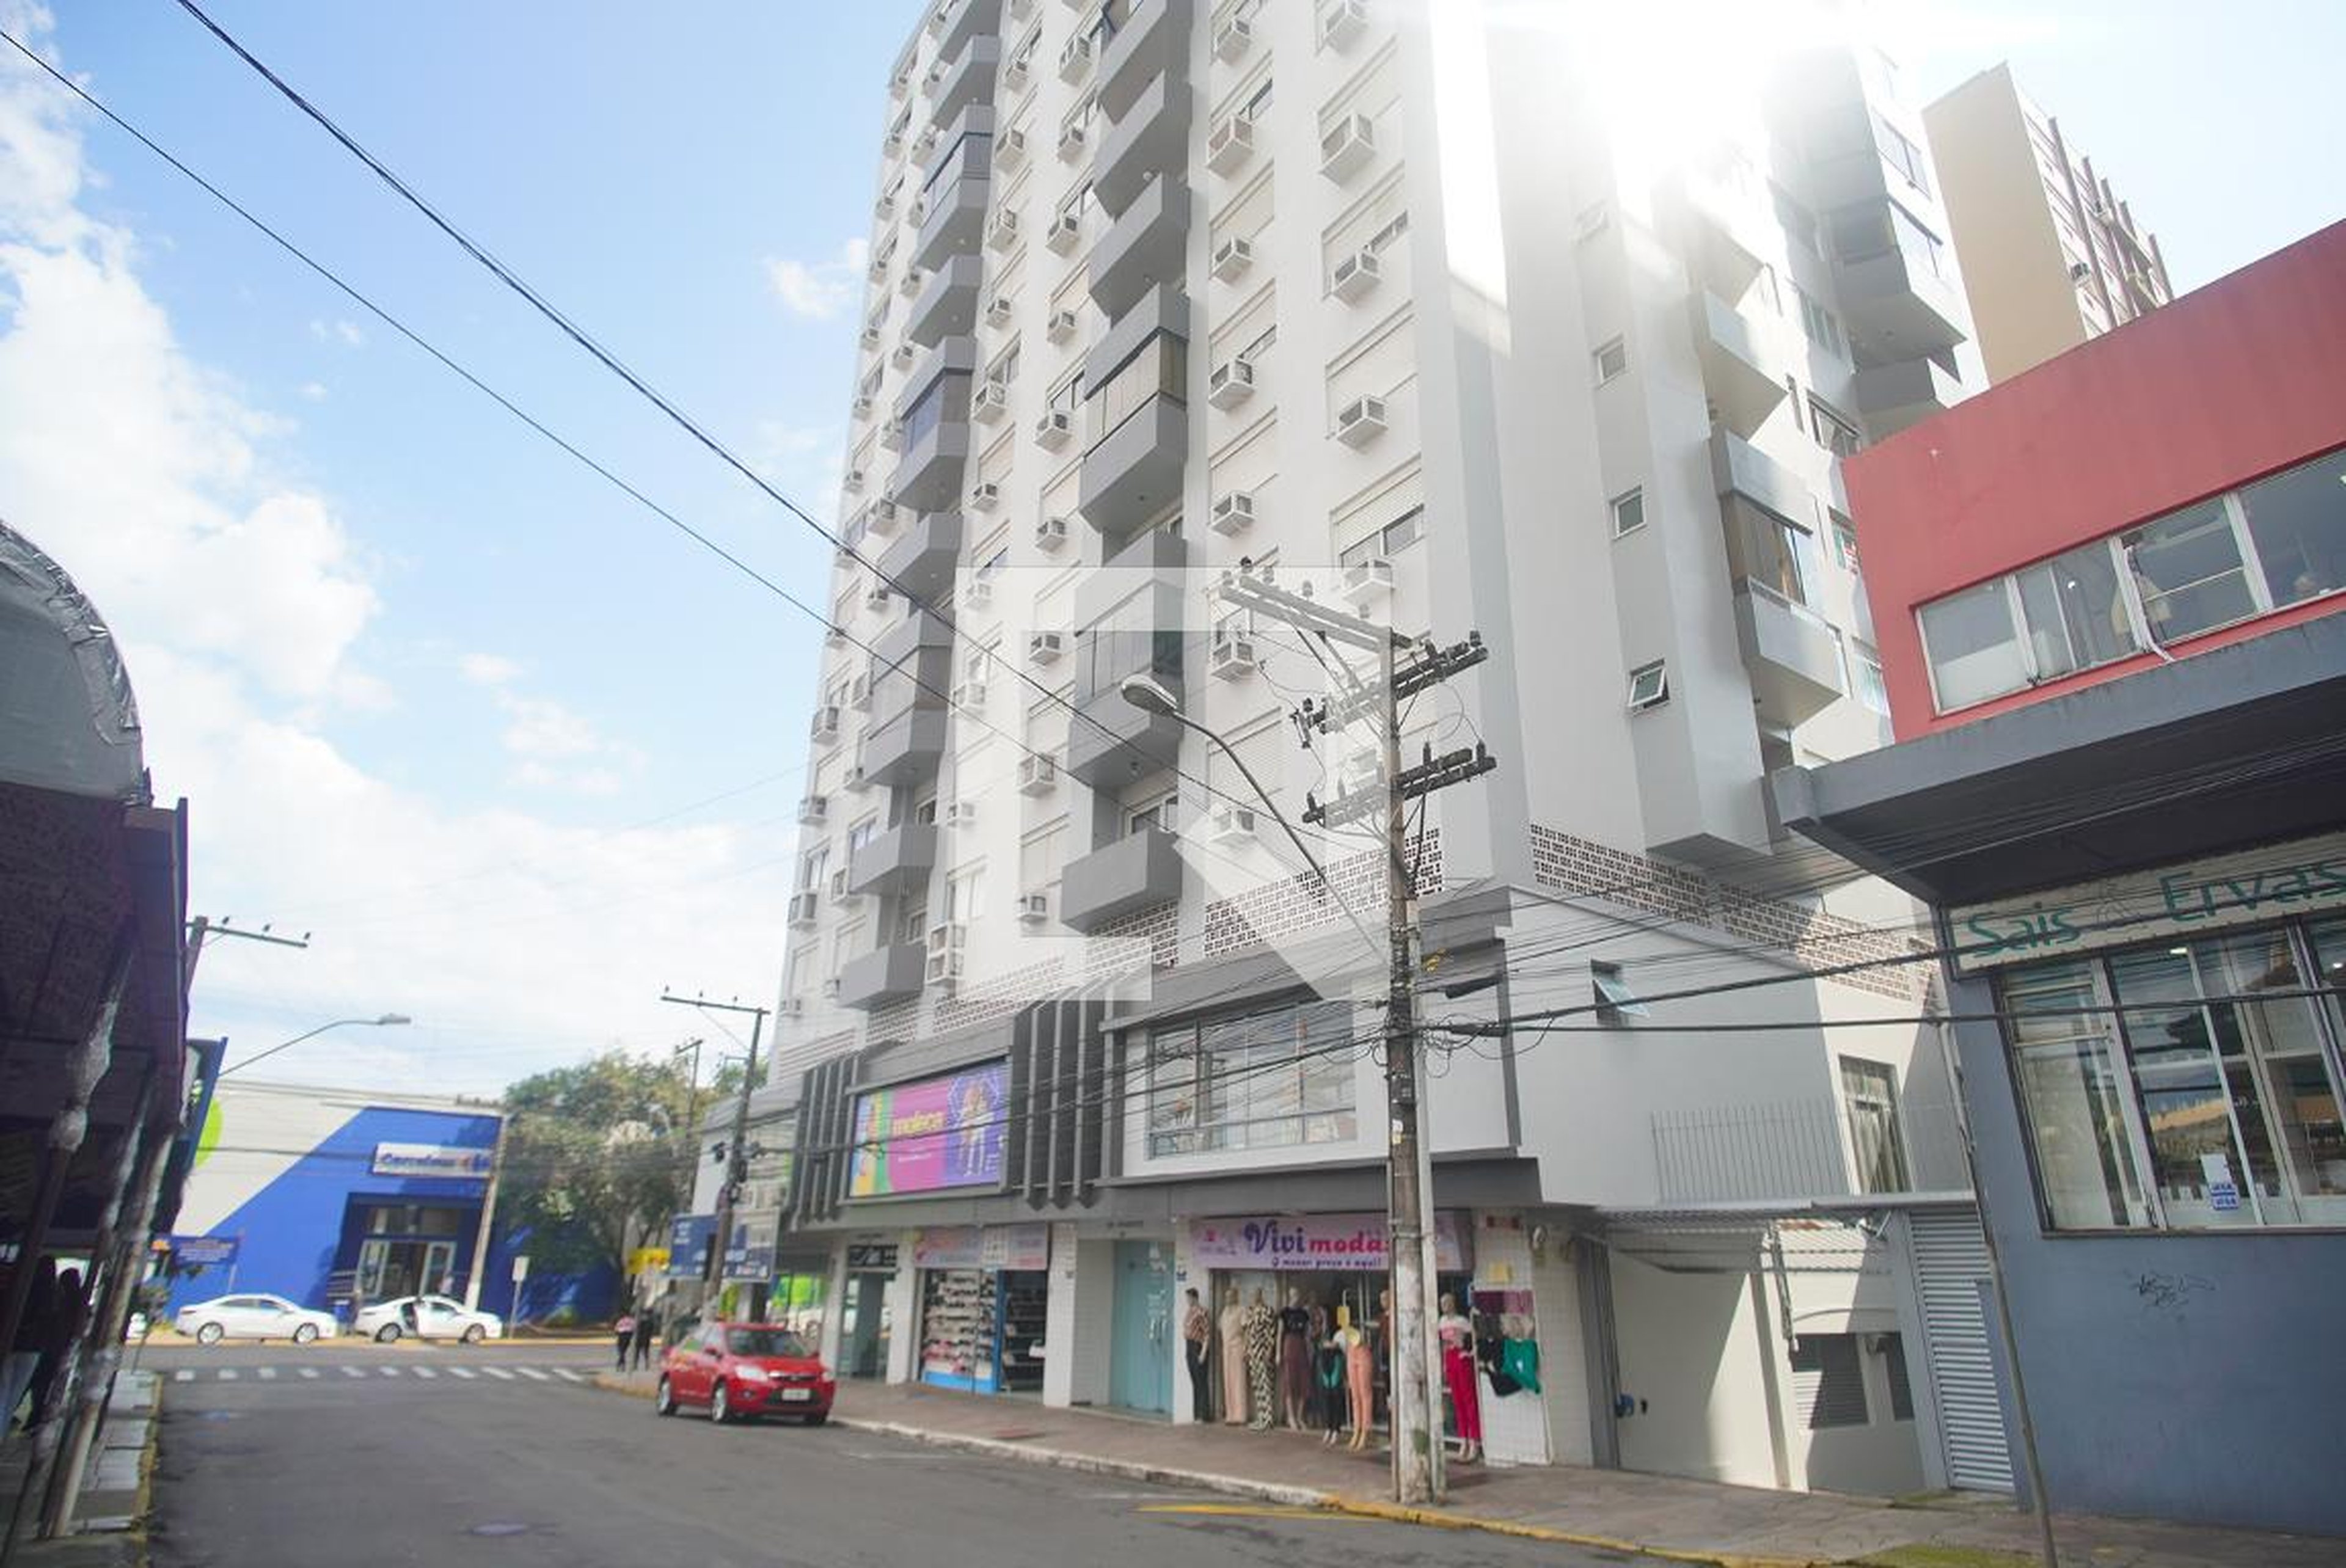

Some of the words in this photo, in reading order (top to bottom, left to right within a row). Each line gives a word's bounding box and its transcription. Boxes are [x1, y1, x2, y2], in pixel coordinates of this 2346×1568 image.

[1968, 900, 2078, 957] Sais
[2158, 859, 2346, 921] Ervas
[1244, 1219, 1305, 1253] Vivi
